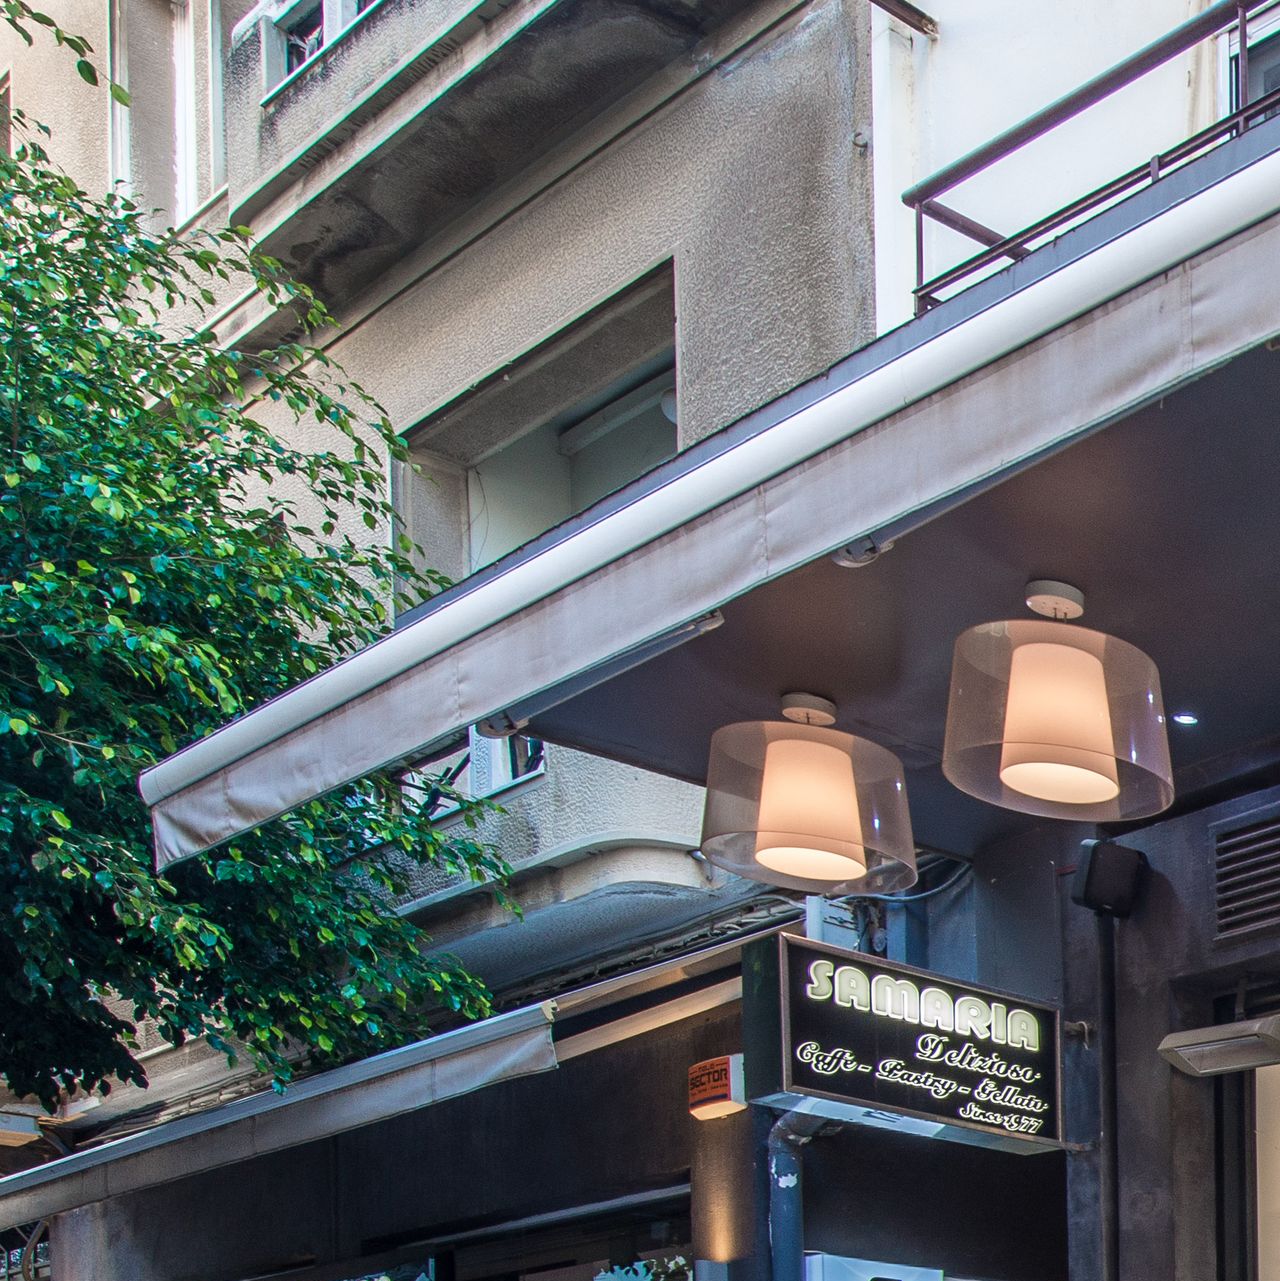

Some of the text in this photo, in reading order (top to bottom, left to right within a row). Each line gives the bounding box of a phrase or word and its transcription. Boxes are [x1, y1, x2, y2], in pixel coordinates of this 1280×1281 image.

[806, 960, 1040, 1052] SAMARIA
[915, 1033, 1042, 1083] Delizioso
[689, 1068, 728, 1091] SECTOR
[875, 1059, 957, 1099] Pastry
[959, 1102, 1045, 1135] Since 1977
